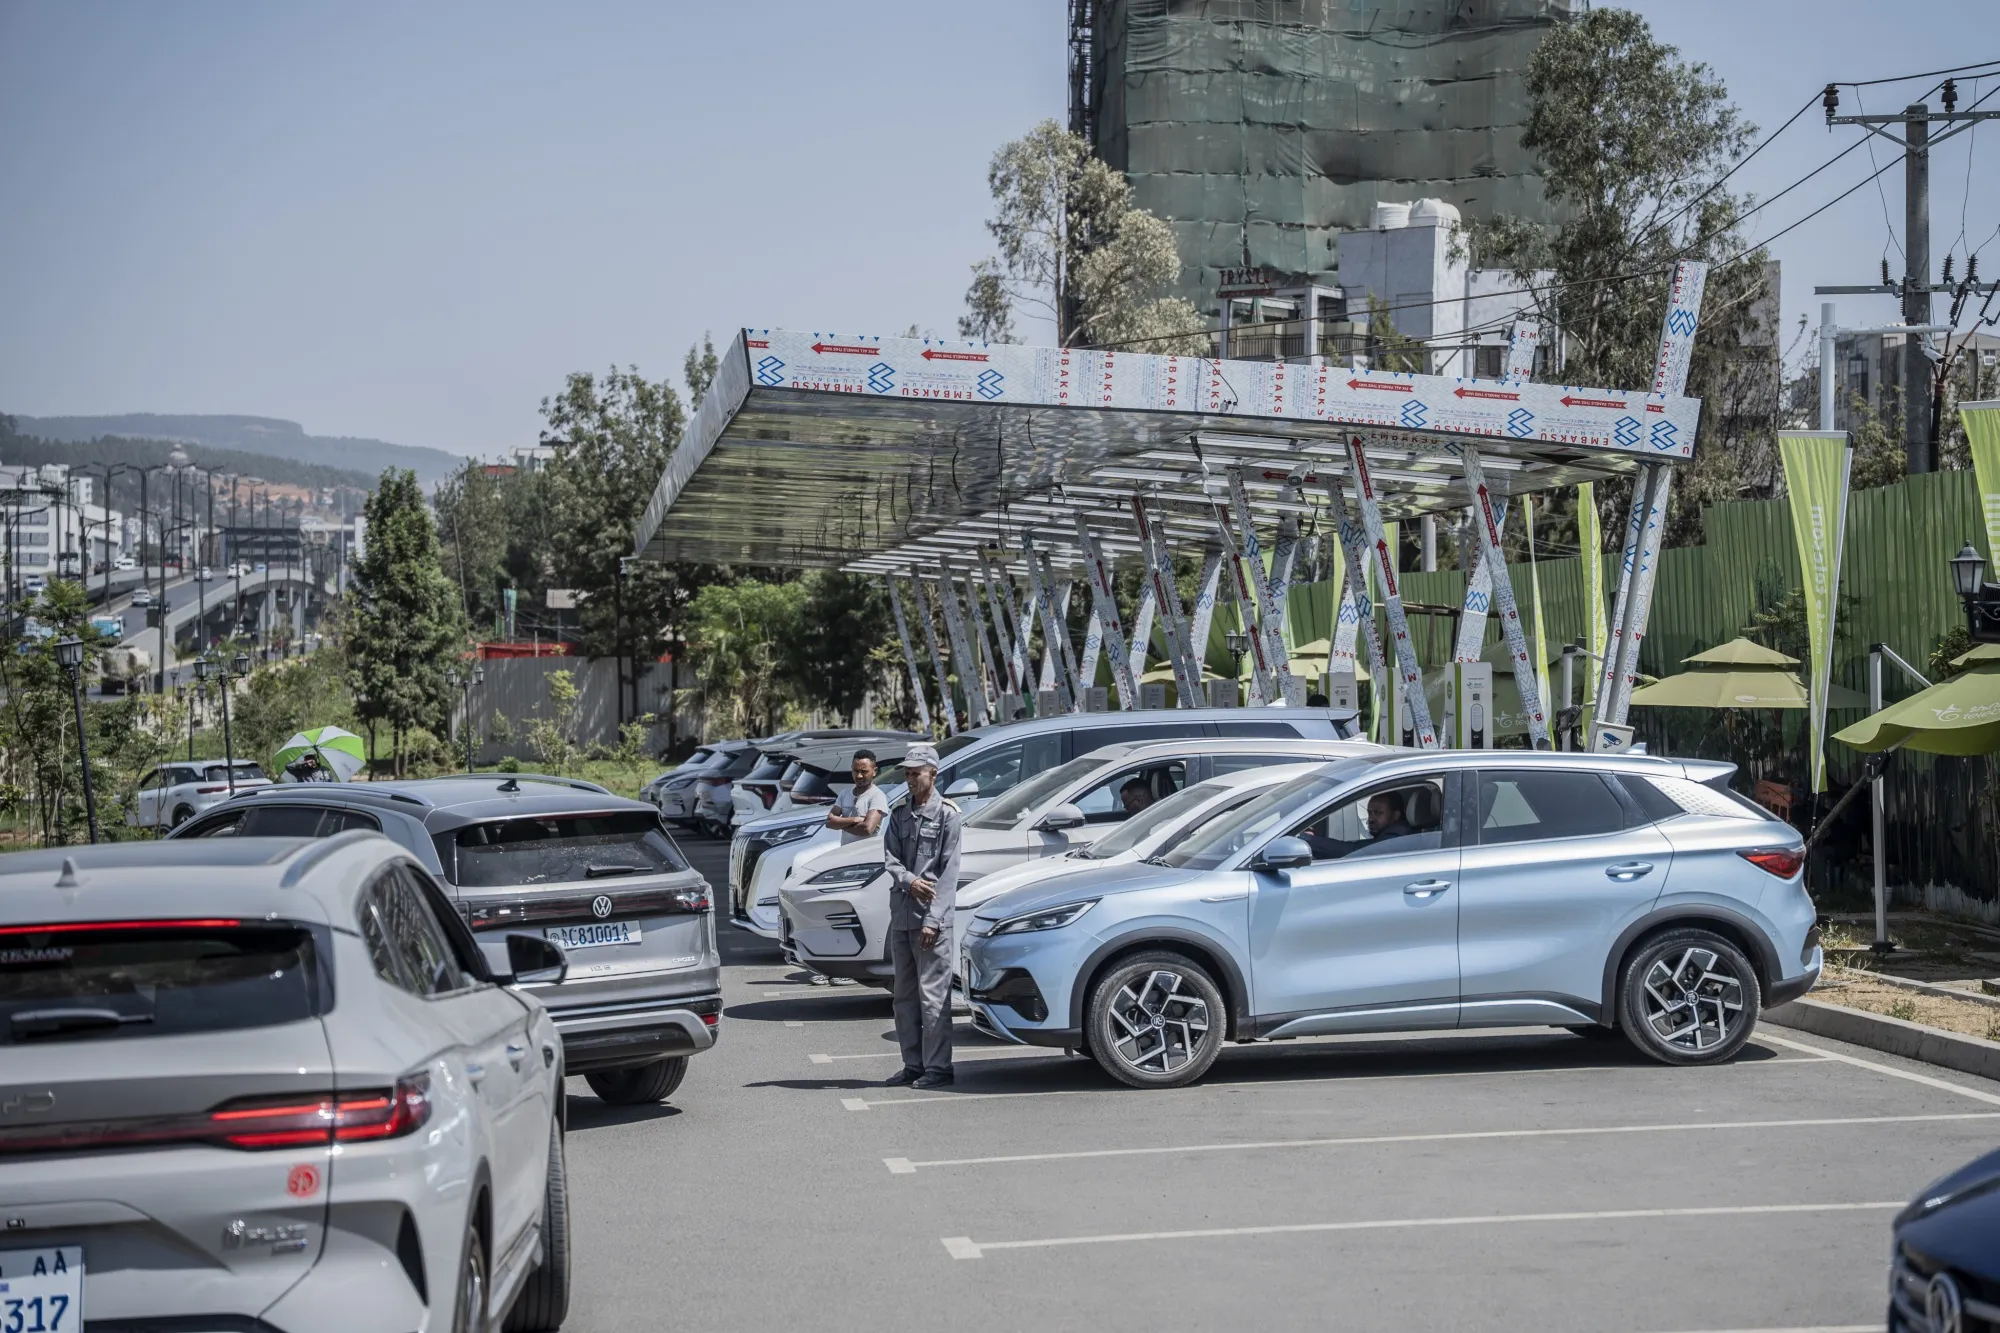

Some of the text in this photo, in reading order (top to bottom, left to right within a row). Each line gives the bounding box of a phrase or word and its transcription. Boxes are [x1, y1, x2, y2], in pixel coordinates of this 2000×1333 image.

[1104, 352, 1114, 408] MBAKS
[792, 381, 863, 392] EMBAKSU
[902, 388, 972, 399] EMBAKSU
[1434, 425, 1502, 436] EMBAKSU
[1541, 433, 1608, 445] EMBAKSU
[569, 924, 621, 946] C81001
[0, 1294, 69, 1333] 317
